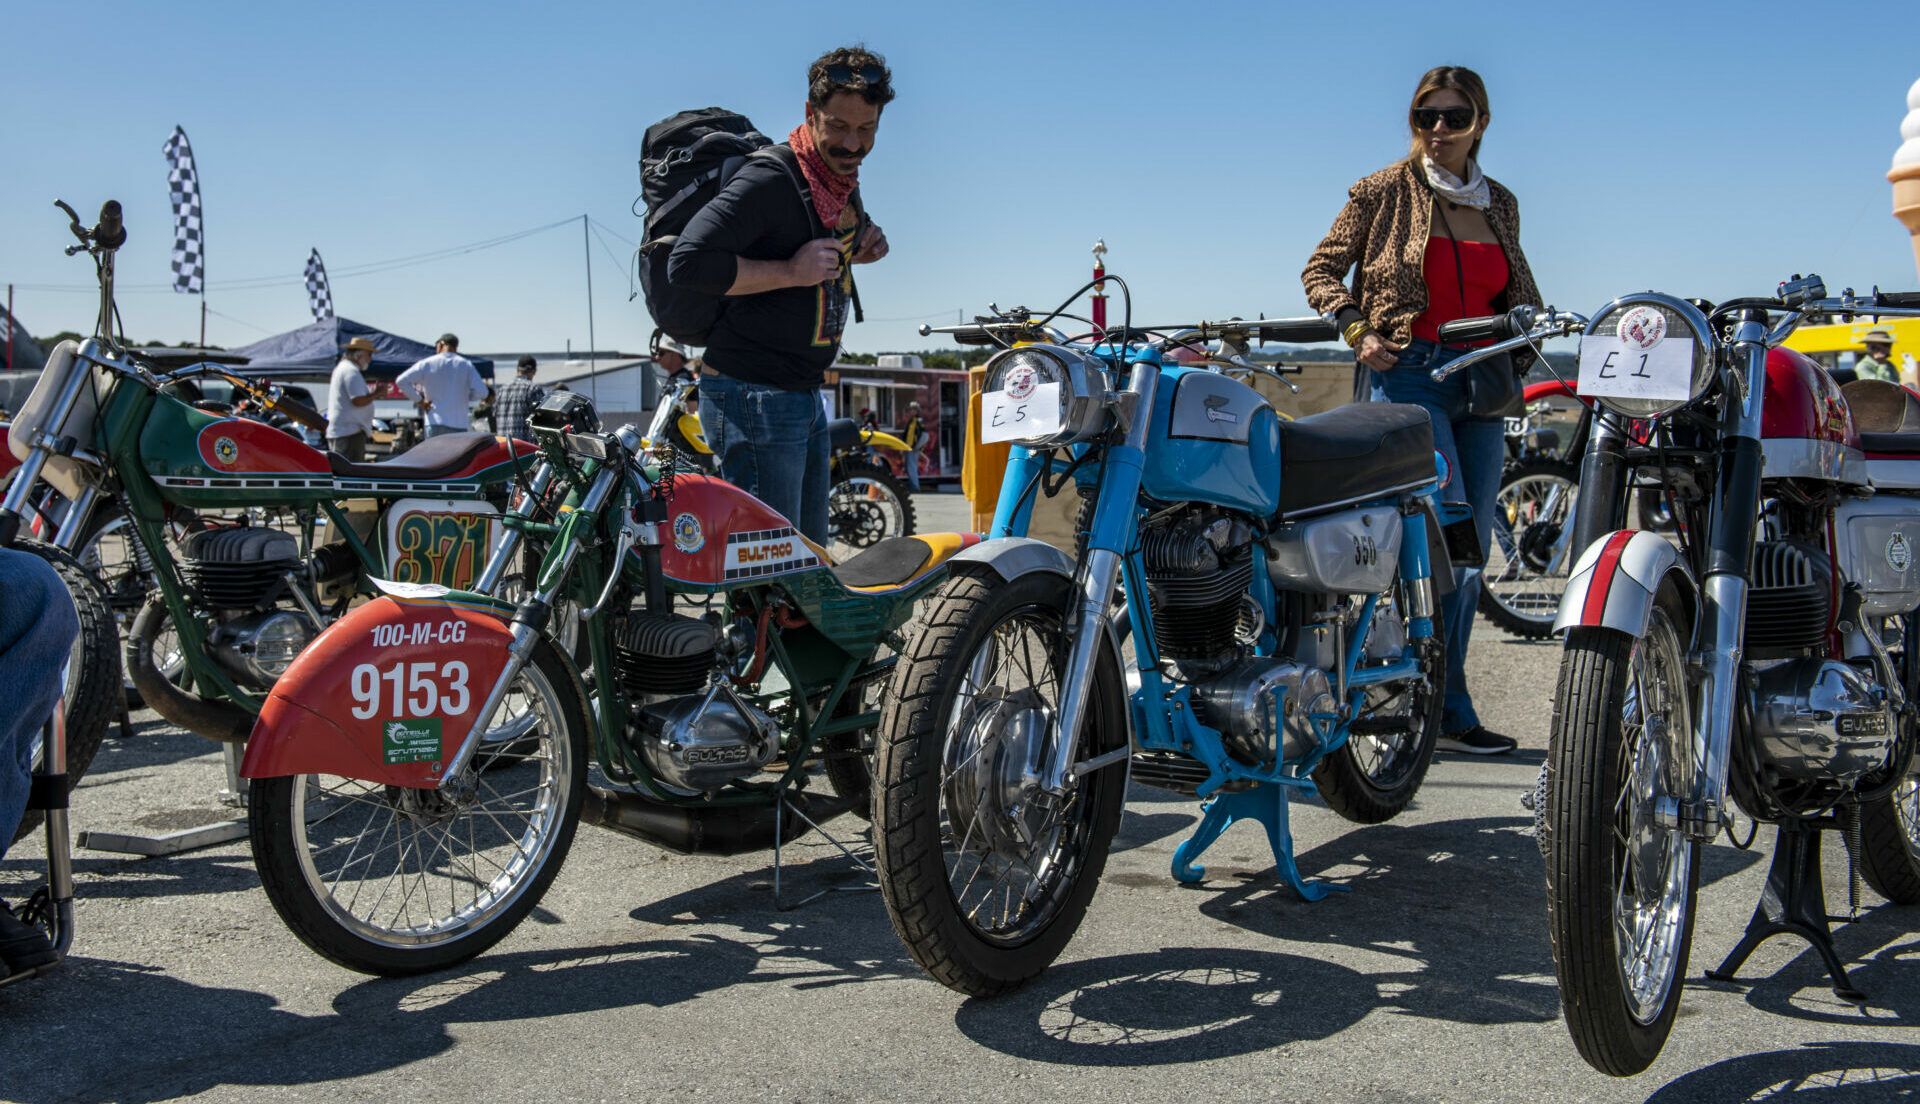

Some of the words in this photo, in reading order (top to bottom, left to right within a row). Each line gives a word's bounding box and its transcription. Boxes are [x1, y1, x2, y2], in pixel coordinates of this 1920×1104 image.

[1599, 351, 1619, 379] E
[1630, 353, 1651, 379] 1
[992, 405, 1006, 427] E
[1015, 404, 1028, 422] 5
[393, 510, 493, 592] 371
[737, 541, 793, 563] BULTACO
[1352, 535, 1376, 566] 350
[370, 620, 467, 647] 100-M-CG
[351, 660, 470, 720] 9153
